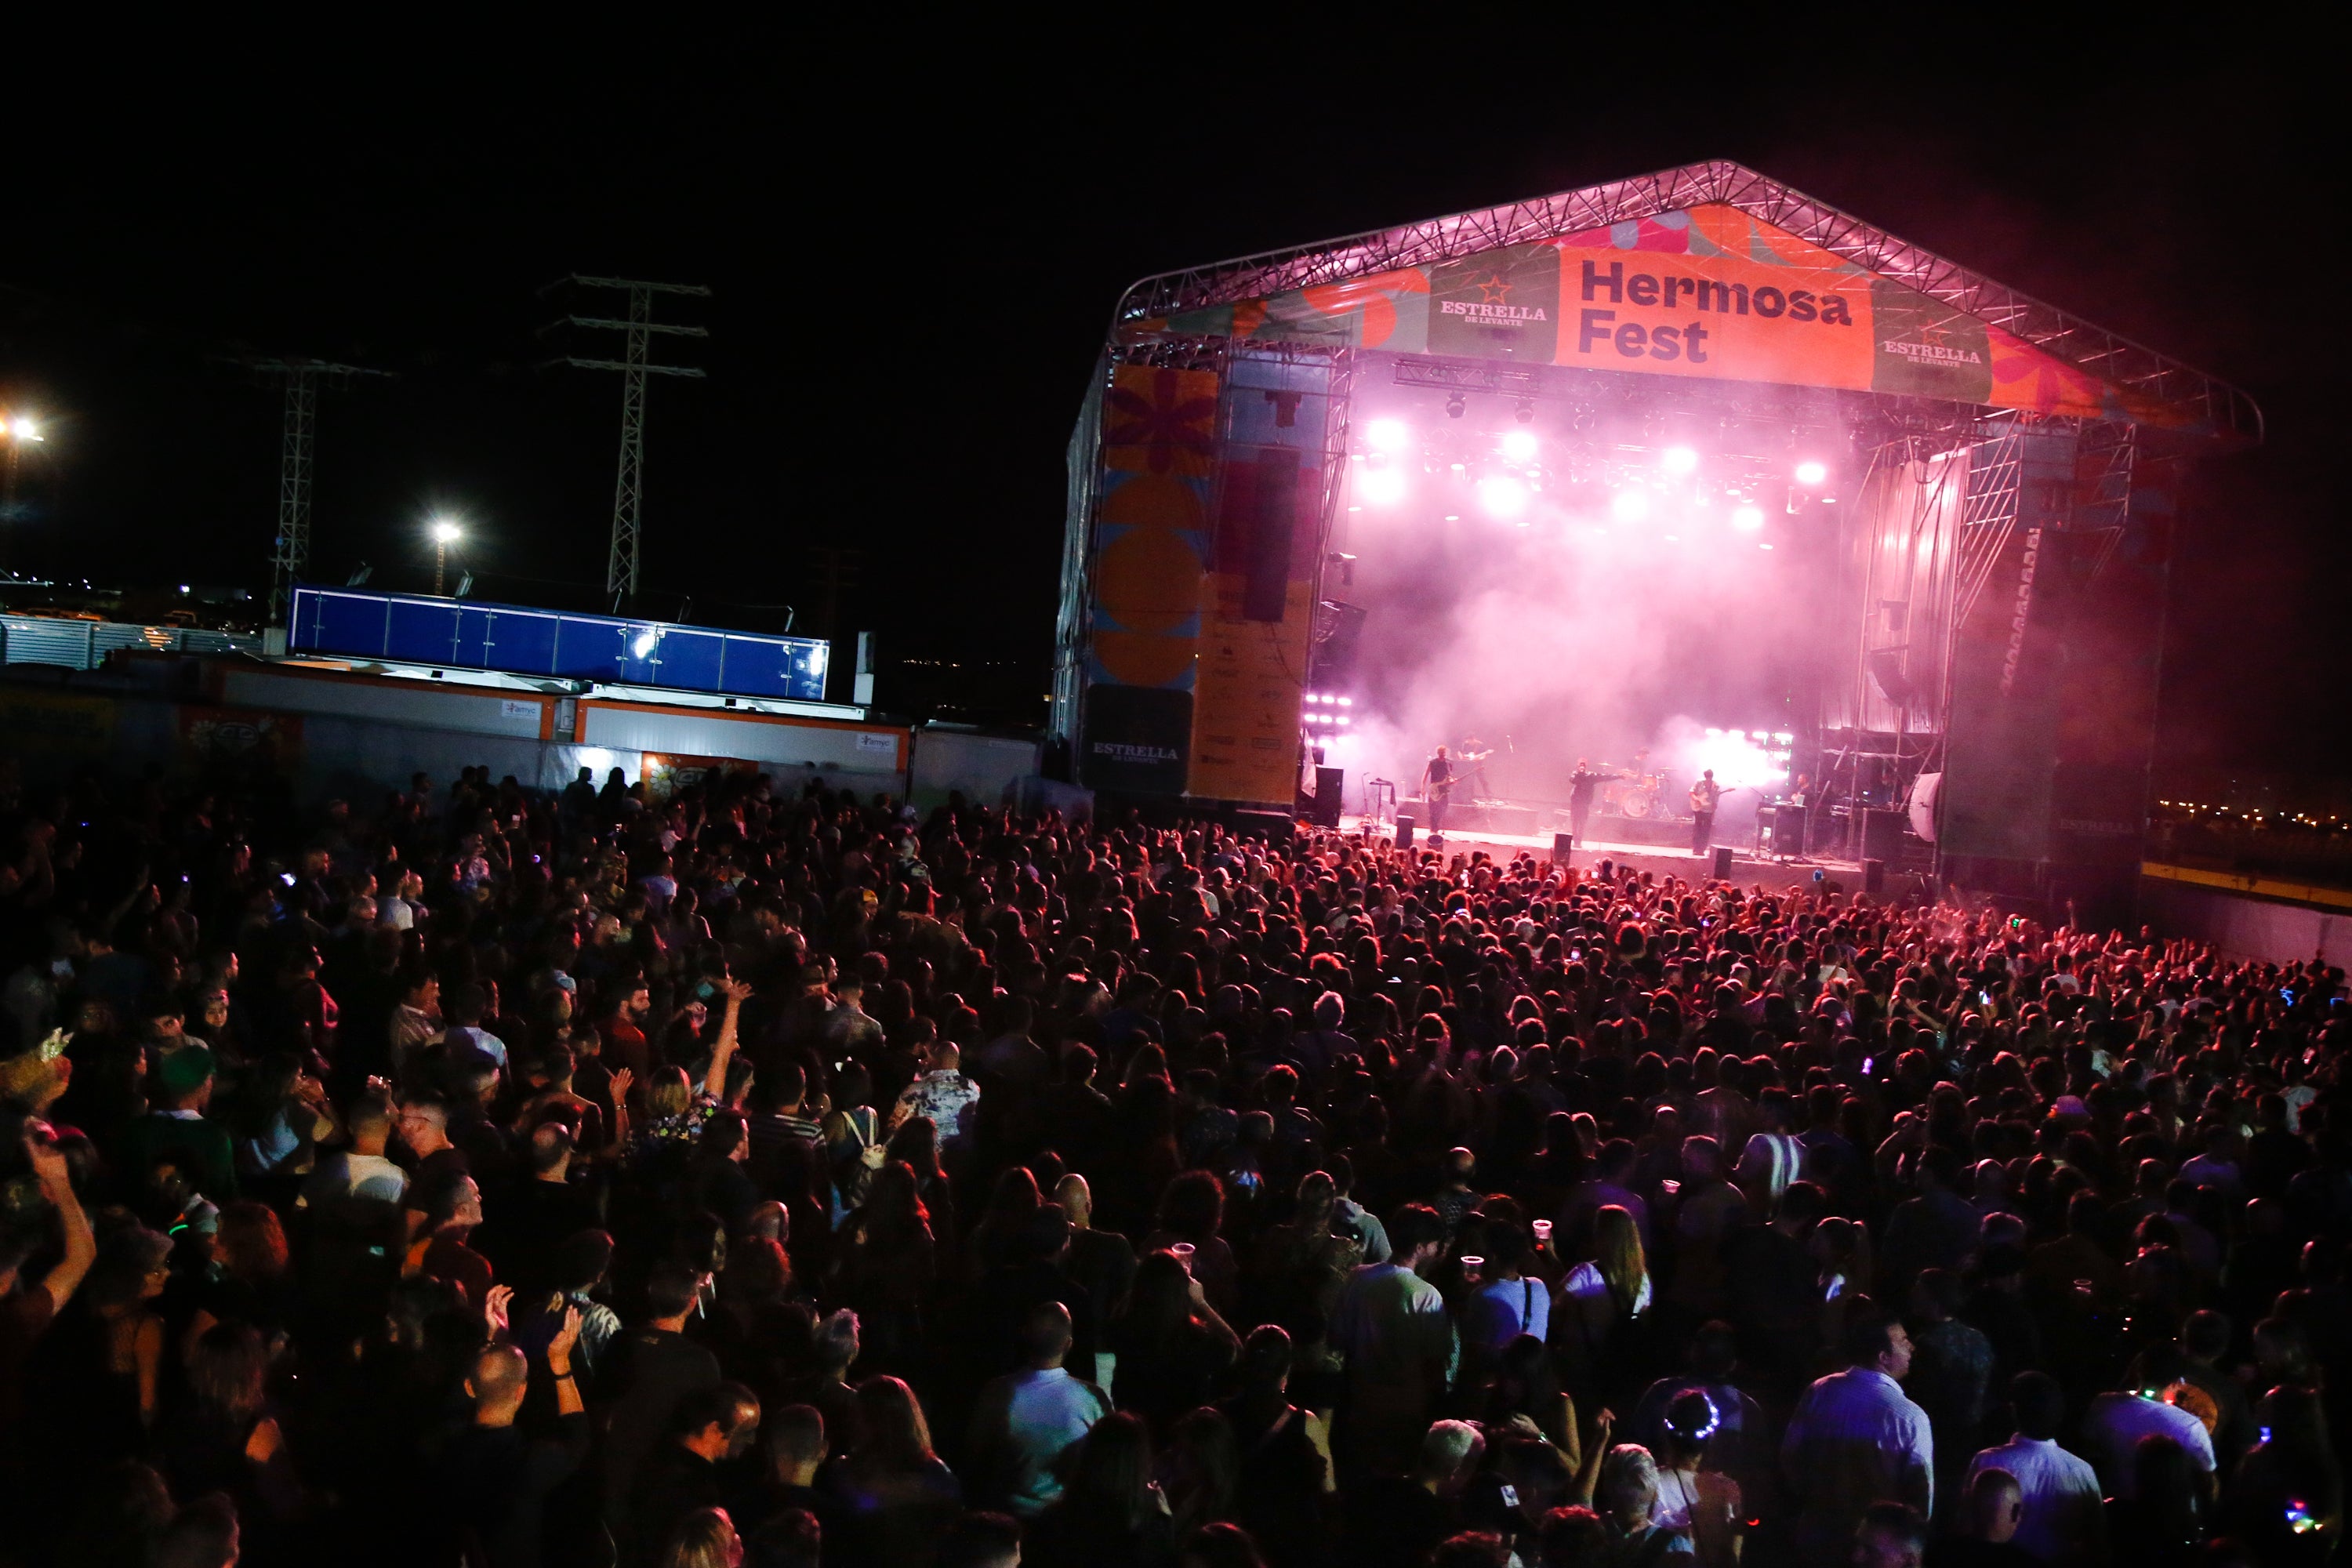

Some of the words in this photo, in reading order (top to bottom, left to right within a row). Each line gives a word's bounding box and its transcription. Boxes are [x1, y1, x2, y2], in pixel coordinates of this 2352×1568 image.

[1581, 260, 1853, 326] Hermosa
[1440, 300, 1547, 321] ESTRELLA
[1479, 317, 1523, 326] LEVANTE
[1578, 307, 1708, 364] Fest
[1884, 340, 1981, 364] ESTRELLA
[1921, 357, 1961, 368] LEVANTE
[1093, 742, 1178, 760] ESTRELLA
